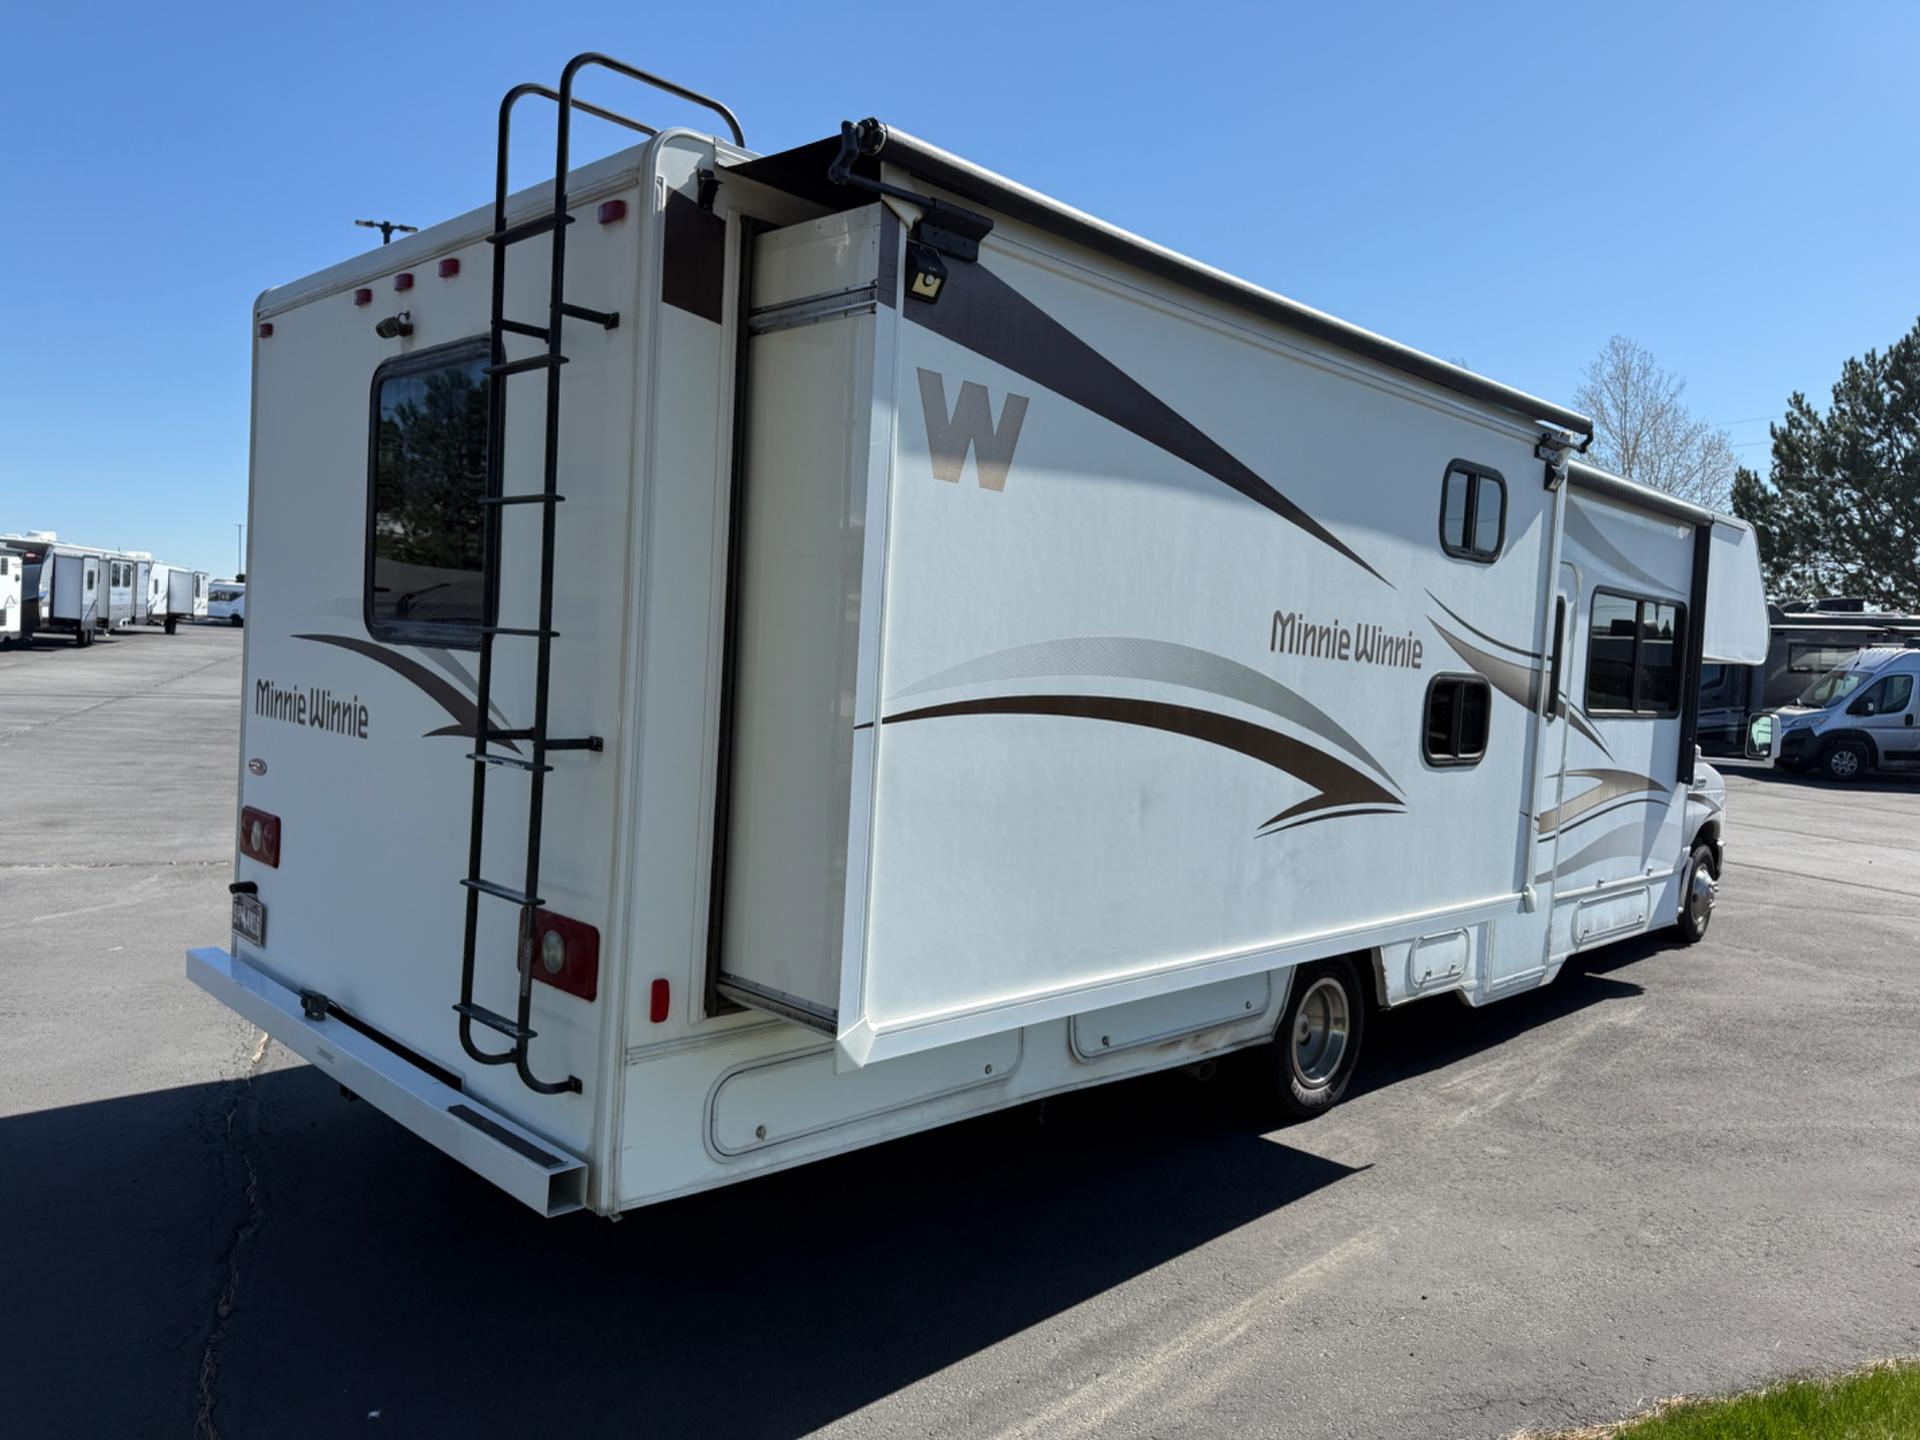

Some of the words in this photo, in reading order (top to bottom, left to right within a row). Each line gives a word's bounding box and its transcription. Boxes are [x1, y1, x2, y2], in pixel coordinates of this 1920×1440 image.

[916, 367, 1030, 492] W
[1270, 610, 1350, 661] Minnie
[1354, 623, 1423, 669] Winnie
[256, 678, 306, 725] Minnie
[309, 687, 369, 740] Winnie
